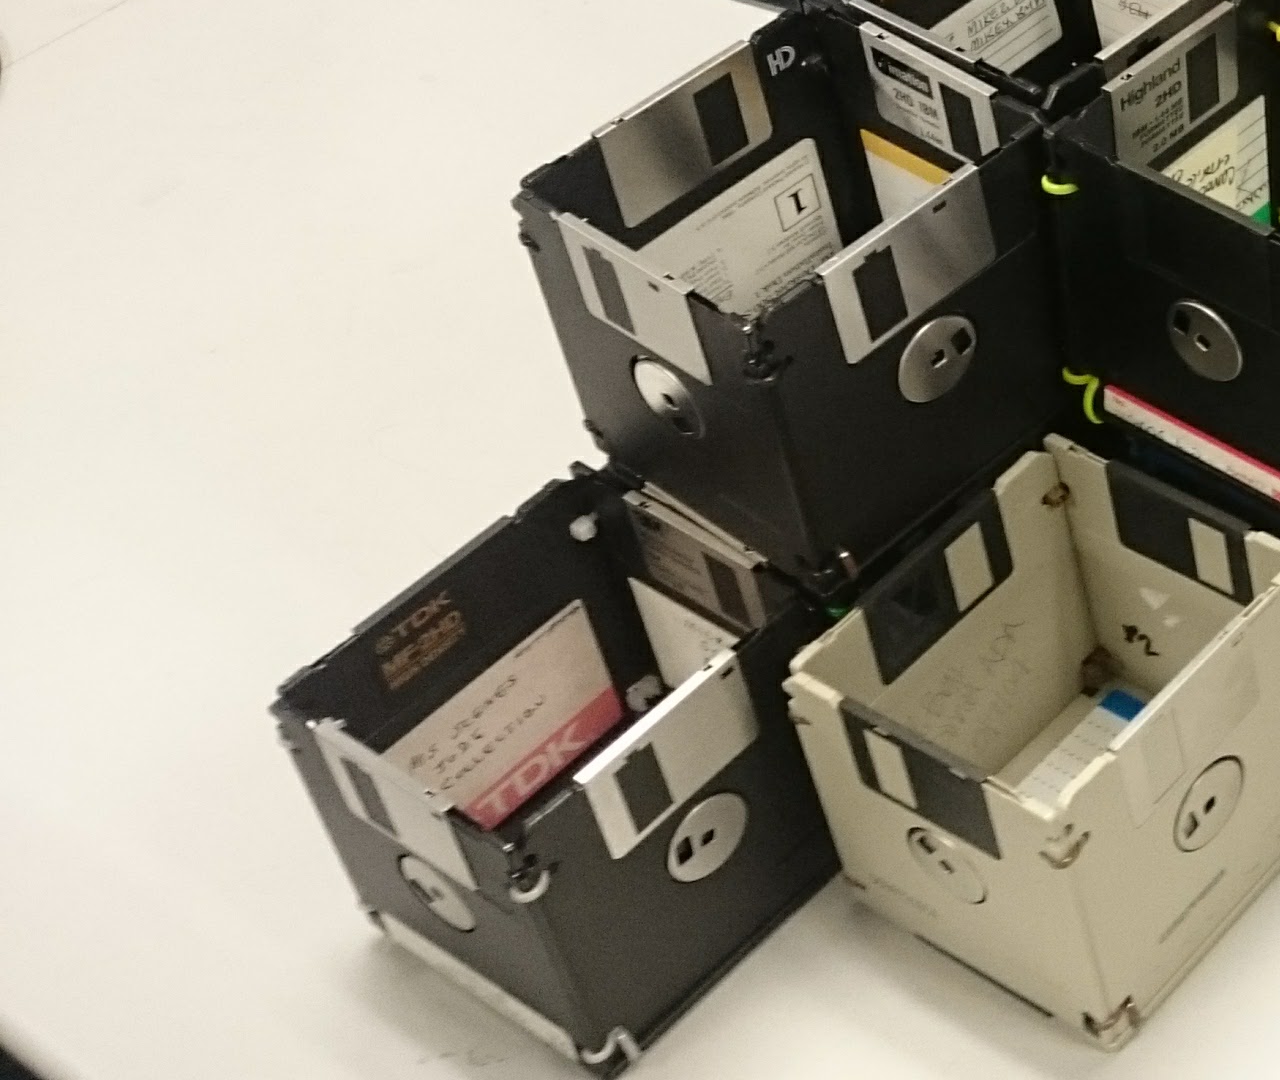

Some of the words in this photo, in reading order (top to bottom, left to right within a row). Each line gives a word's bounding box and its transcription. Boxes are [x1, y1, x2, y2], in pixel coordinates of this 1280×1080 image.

[766, 45, 796, 77] HD
[1120, 57, 1181, 112] Highland
[1154, 80, 1183, 108] 2HD
[788, 188, 807, 214] 1
[391, 591, 451, 637] TDK
[471, 722, 588, 813] TDK
